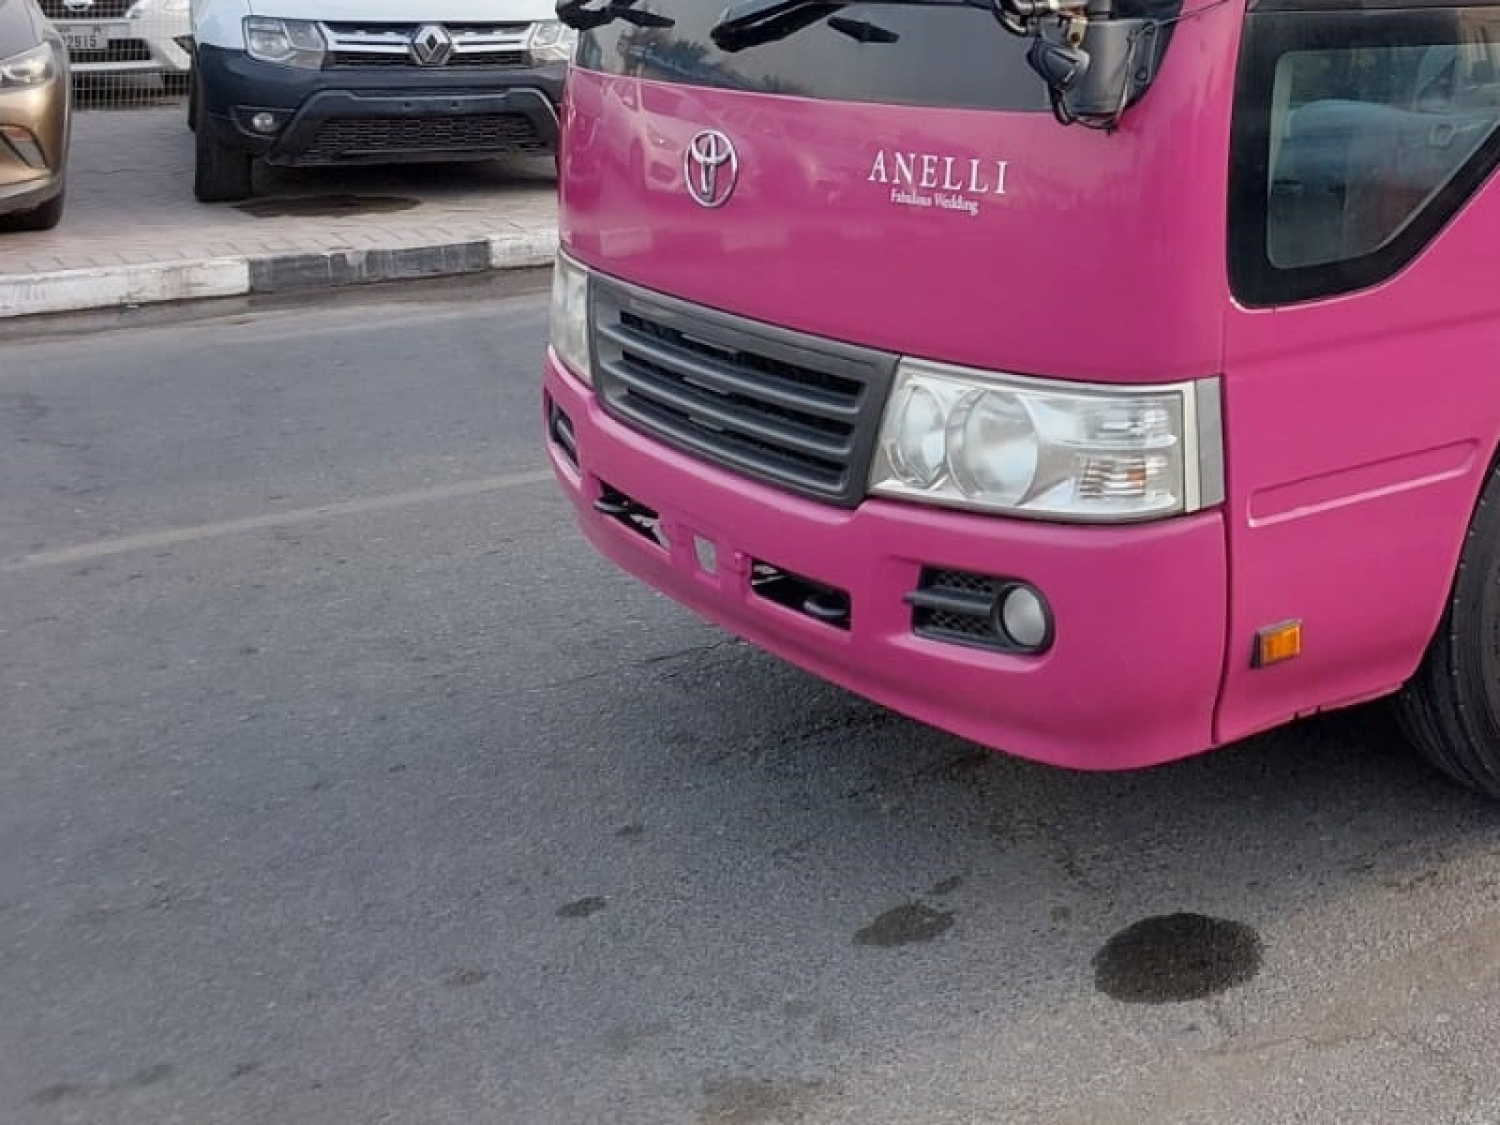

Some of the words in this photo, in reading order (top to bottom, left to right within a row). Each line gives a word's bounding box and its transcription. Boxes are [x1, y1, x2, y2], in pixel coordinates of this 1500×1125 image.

[866, 148, 1009, 195] ANELLI
[890, 187, 932, 207] Fabulous
[933, 191, 980, 217] Wedding
